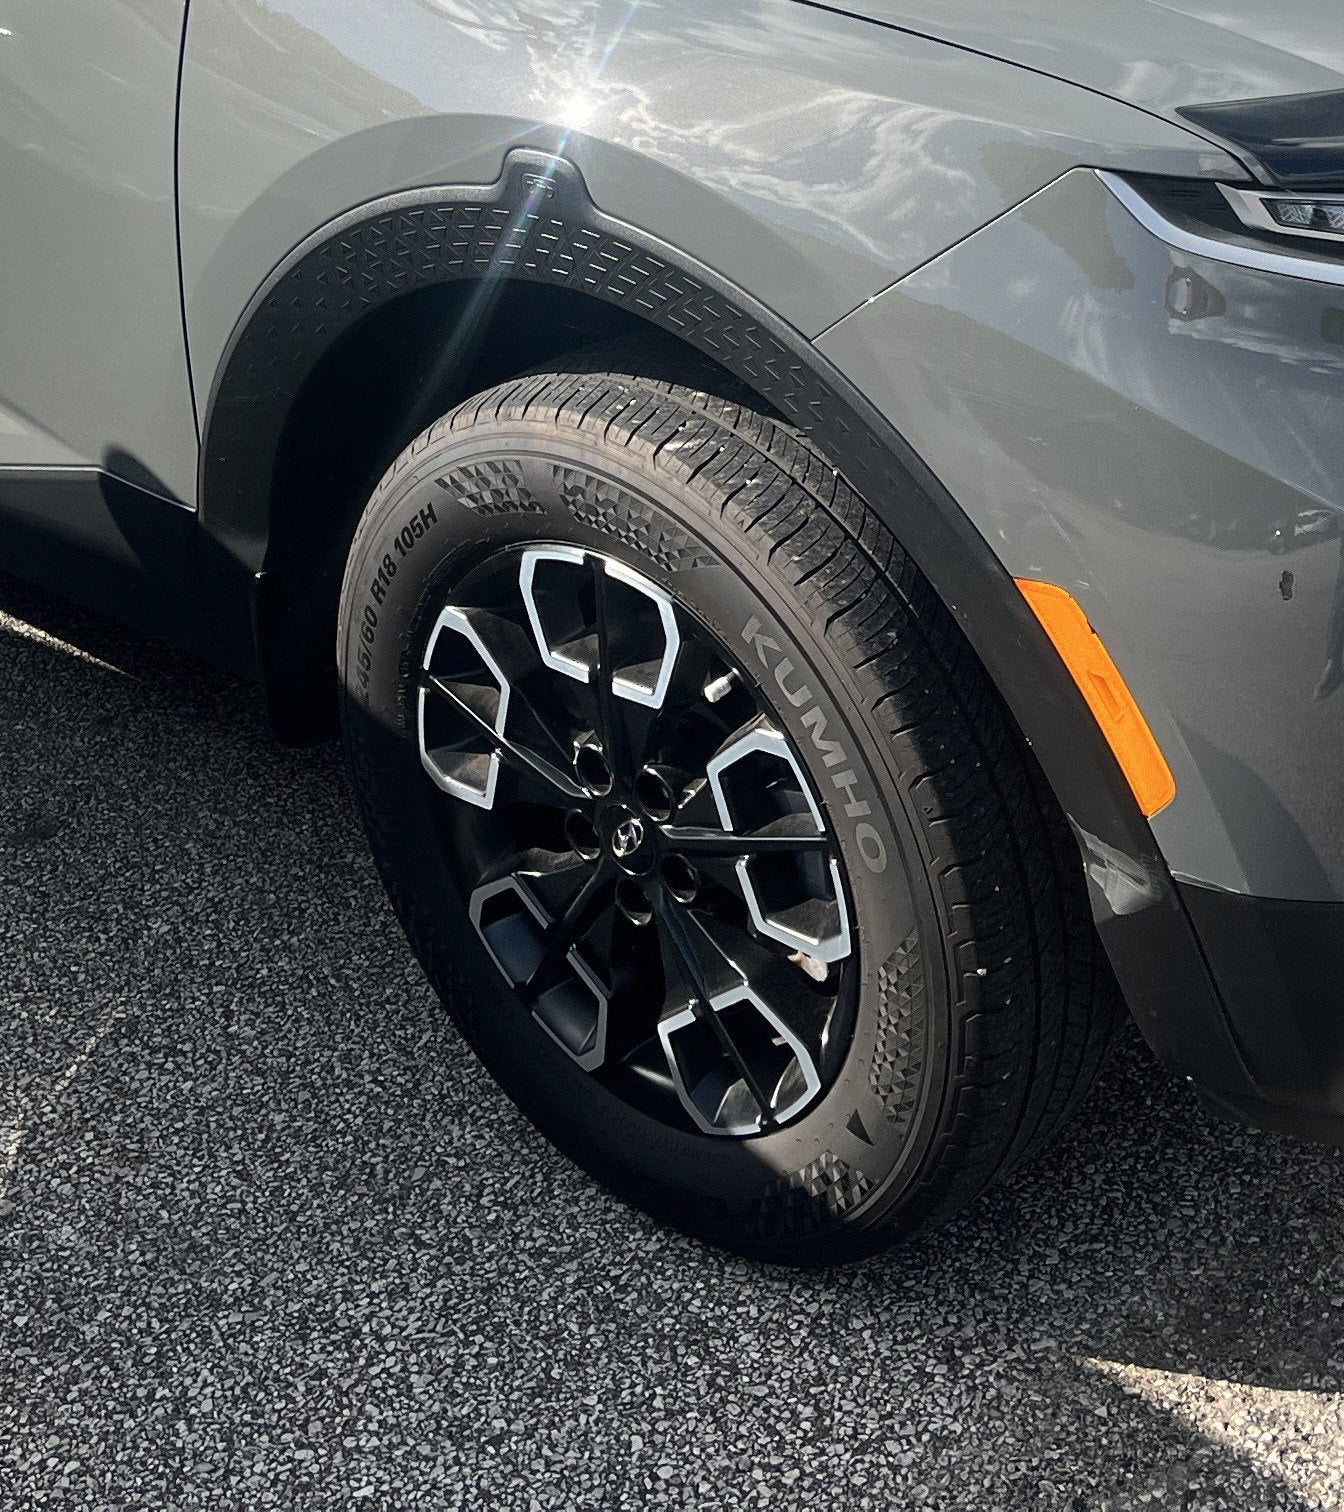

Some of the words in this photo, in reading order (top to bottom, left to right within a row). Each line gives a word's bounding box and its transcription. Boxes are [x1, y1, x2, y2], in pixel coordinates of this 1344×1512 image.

[369, 552, 398, 605] R18
[393, 501, 439, 557] 105H
[740, 614, 888, 874] KUMHO
